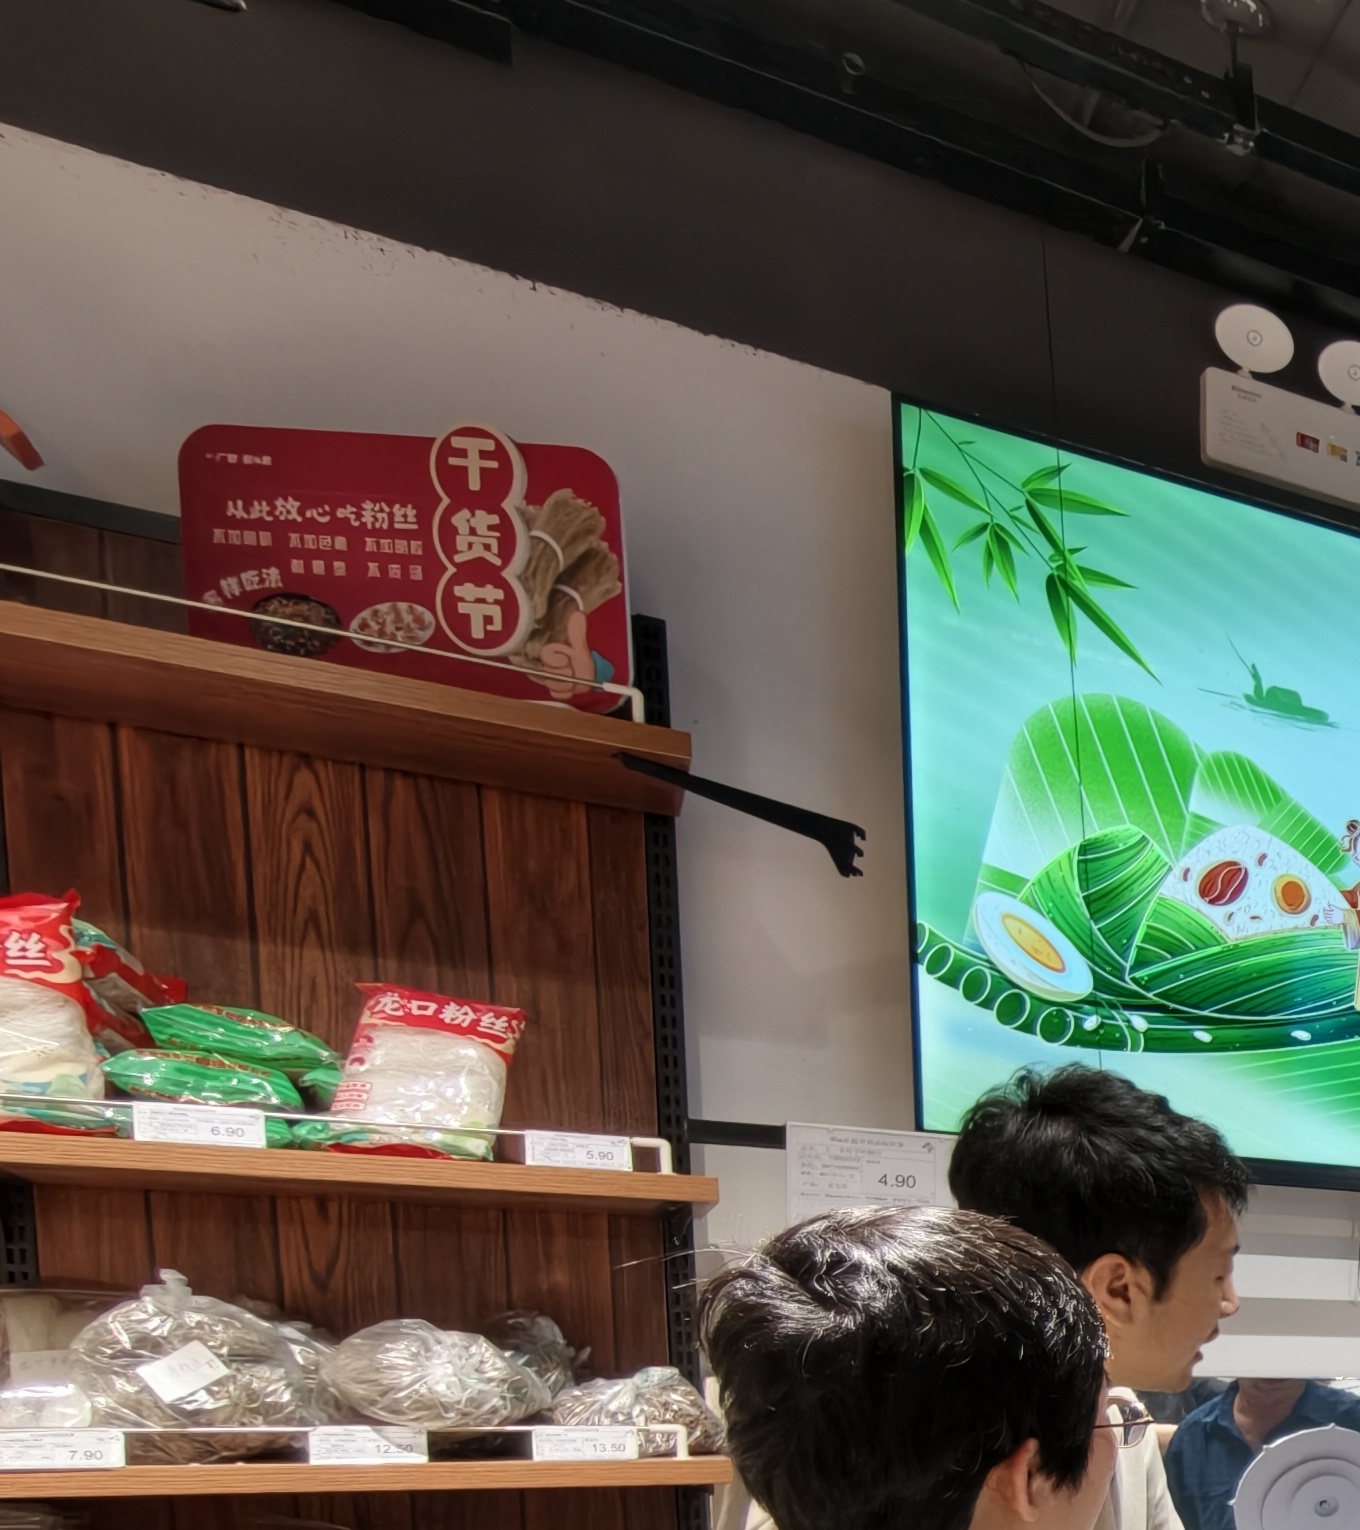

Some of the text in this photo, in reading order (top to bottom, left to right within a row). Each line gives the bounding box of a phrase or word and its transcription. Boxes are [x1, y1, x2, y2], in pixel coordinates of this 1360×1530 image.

[226, 497, 419, 530] 从此放心吃粉丝
[448, 437, 502, 639] 干货节
[372, 992, 508, 1037] 龙口粉丝
[211, 1126, 244, 1138] 6.90
[586, 1150, 614, 1161] 5.90
[877, 1173, 917, 1188] 4.90
[592, 1443, 626, 1453] 13.50
[68, 1450, 103, 1461] 7.90
